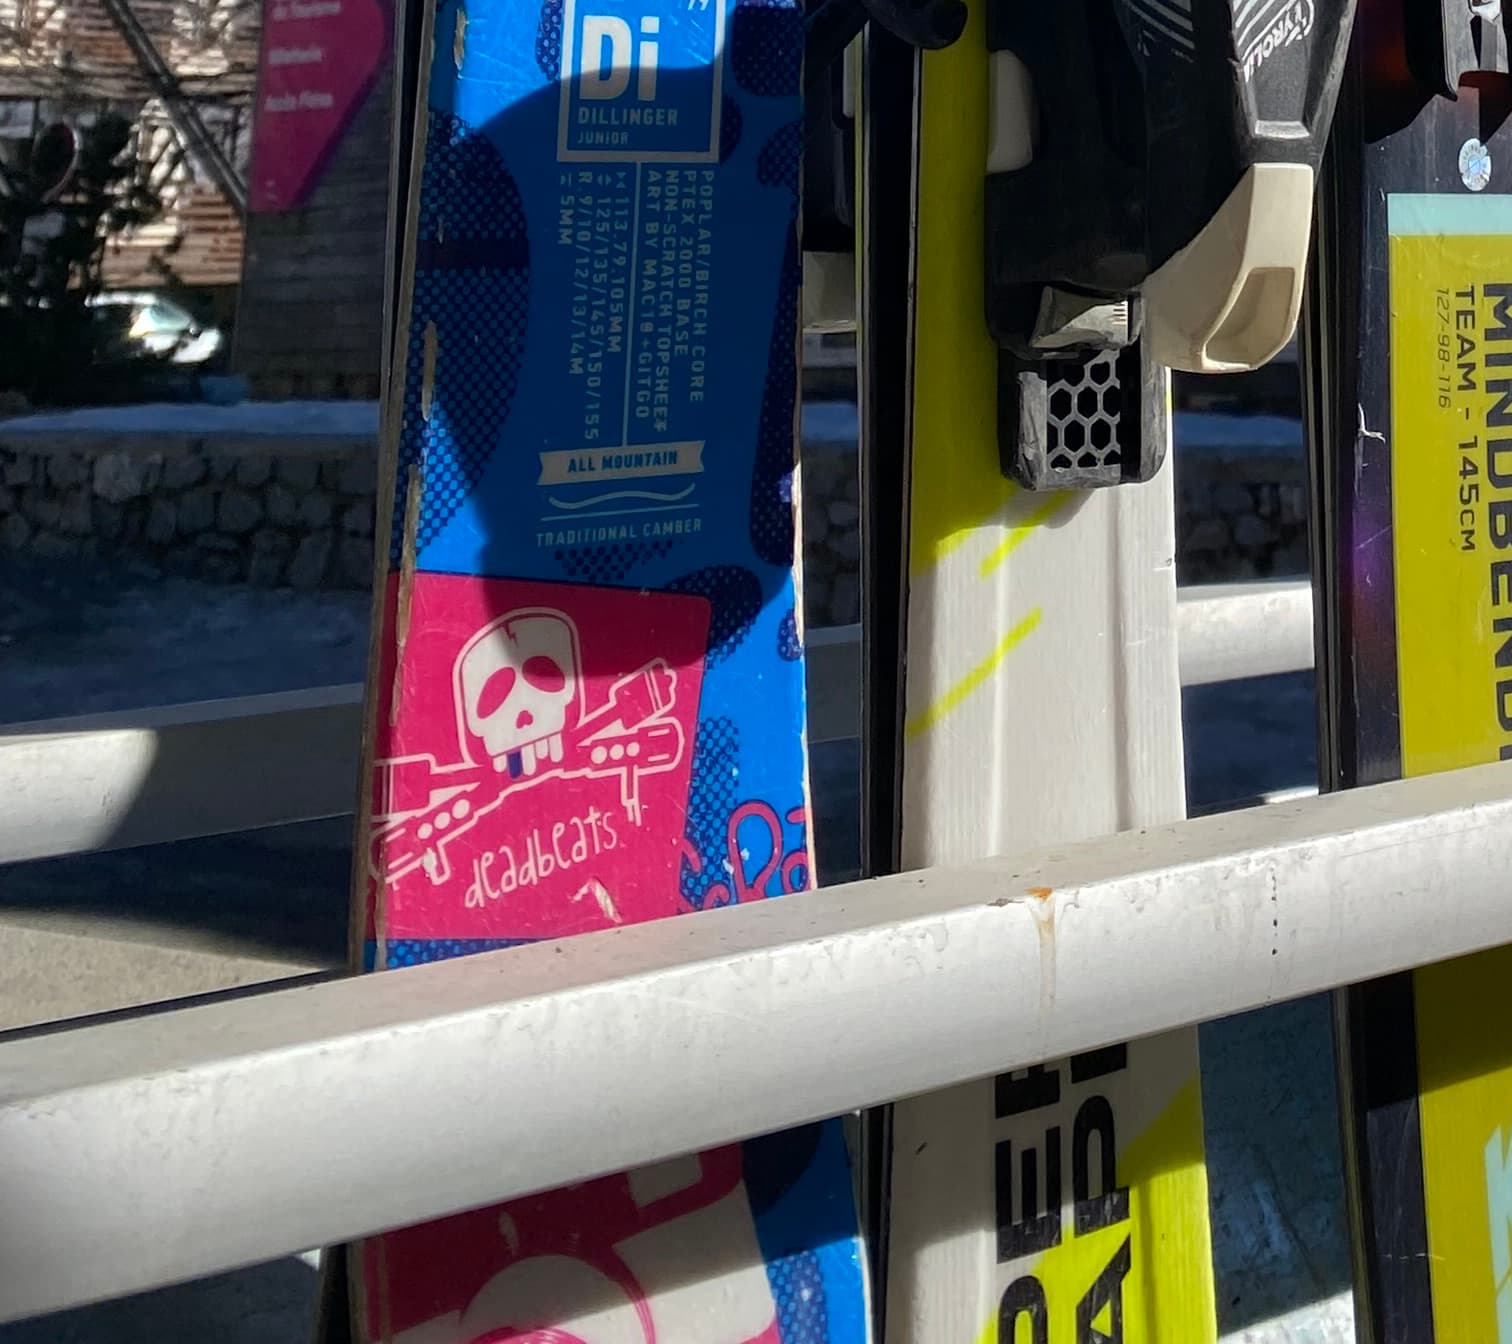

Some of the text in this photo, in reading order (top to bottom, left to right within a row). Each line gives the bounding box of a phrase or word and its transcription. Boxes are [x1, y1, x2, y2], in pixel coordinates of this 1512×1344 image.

[579, 15, 660, 102] Di
[577, 132, 629, 145] JUNIOR
[578, 107, 678, 126] DILLINGER
[647, 170, 662, 212] ART
[645, 222, 659, 248] BY
[659, 170, 680, 317] NON-SCRATCH
[674, 170, 697, 357] PTEX 2000 BASE
[689, 345, 706, 403] CORE
[1437, 288, 1452, 409] 127-98-116
[1455, 286, 1477, 392] TEAM
[567, 451, 678, 473] ALL MOUNTAIN
[1458, 436, 1480, 552] 145CM
[537, 518, 702, 548] TRADITIONAL CAMBER
[465, 805, 617, 909] deadbeats
